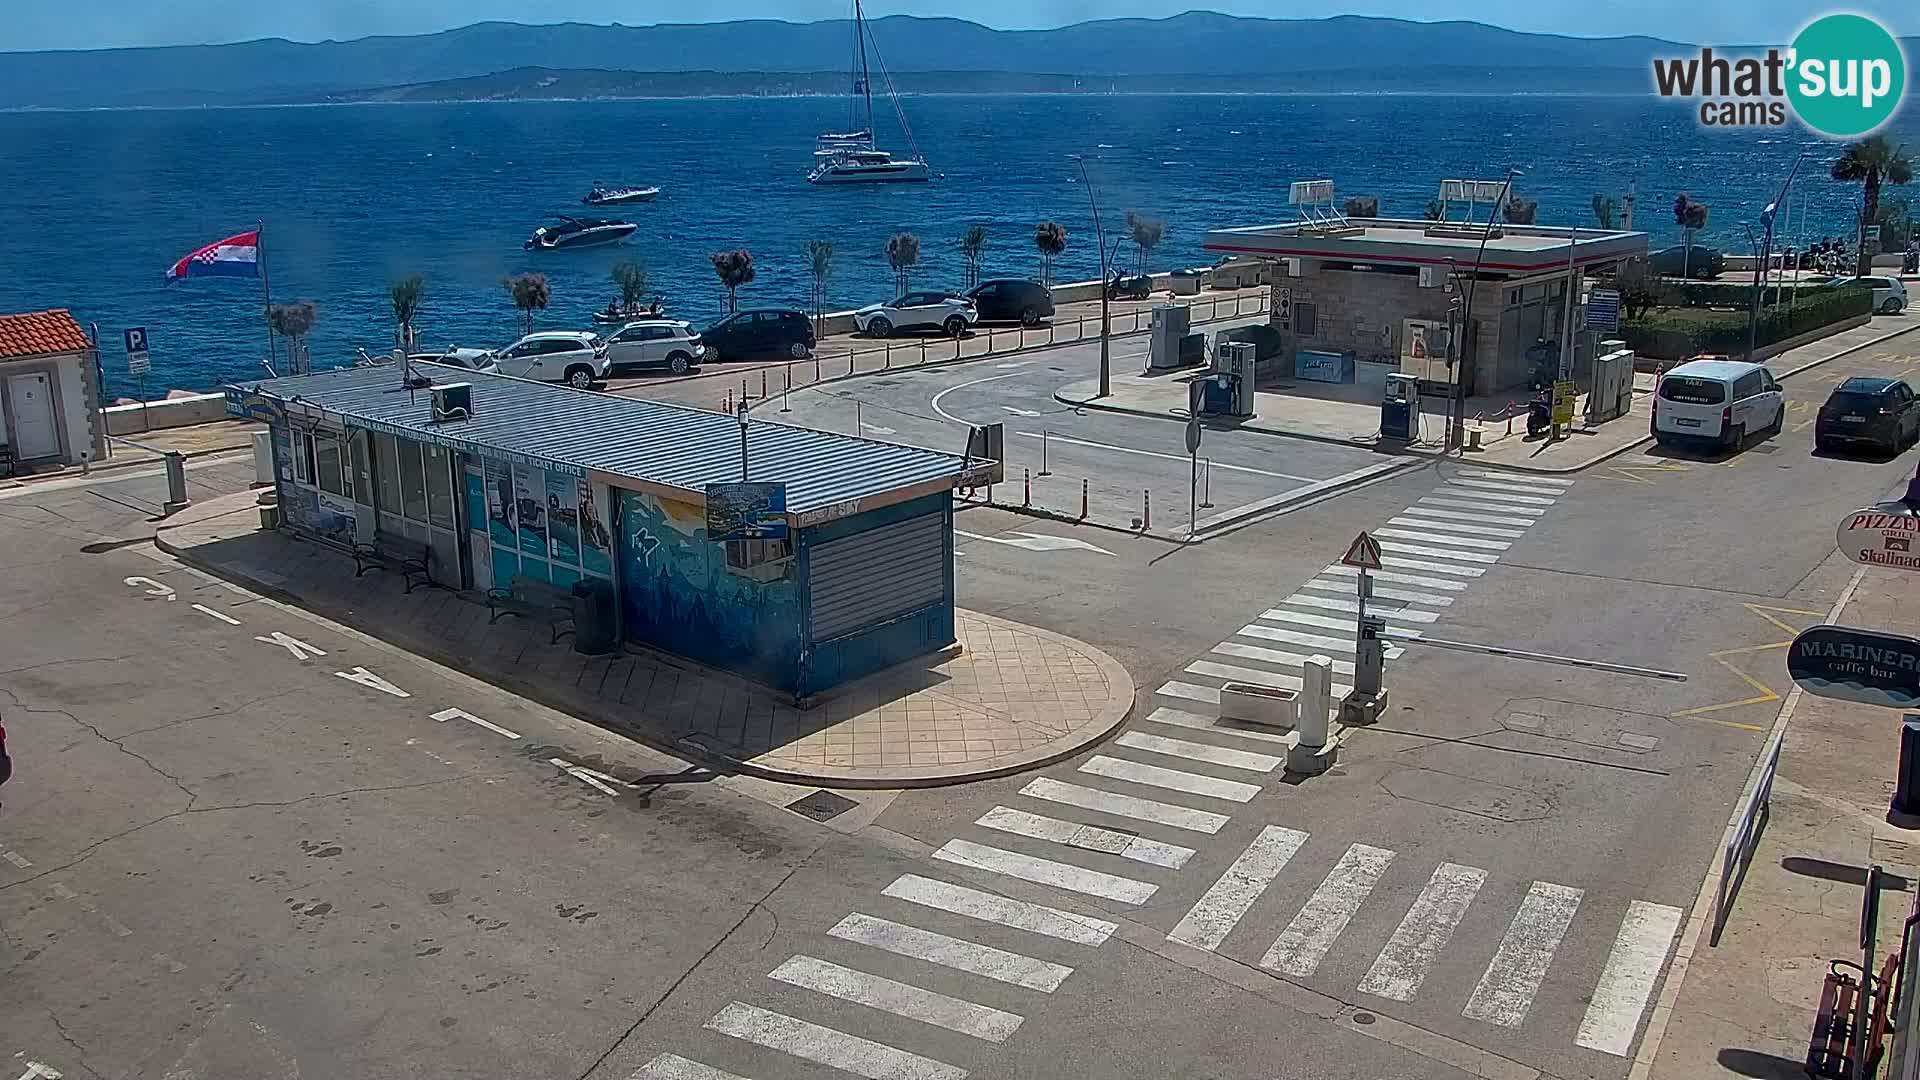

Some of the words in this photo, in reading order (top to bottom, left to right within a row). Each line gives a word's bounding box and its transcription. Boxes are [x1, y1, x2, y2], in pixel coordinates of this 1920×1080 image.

[129, 330, 142, 349] P
[436, 436, 467, 451] POSTAJA
[528, 456, 554, 471] TICKET
[554, 463, 583, 477] OFFICE
[1881, 529, 1917, 540] GRILL
[1828, 661, 1865, 673] caffe
[1870, 665, 1896, 679] bar
